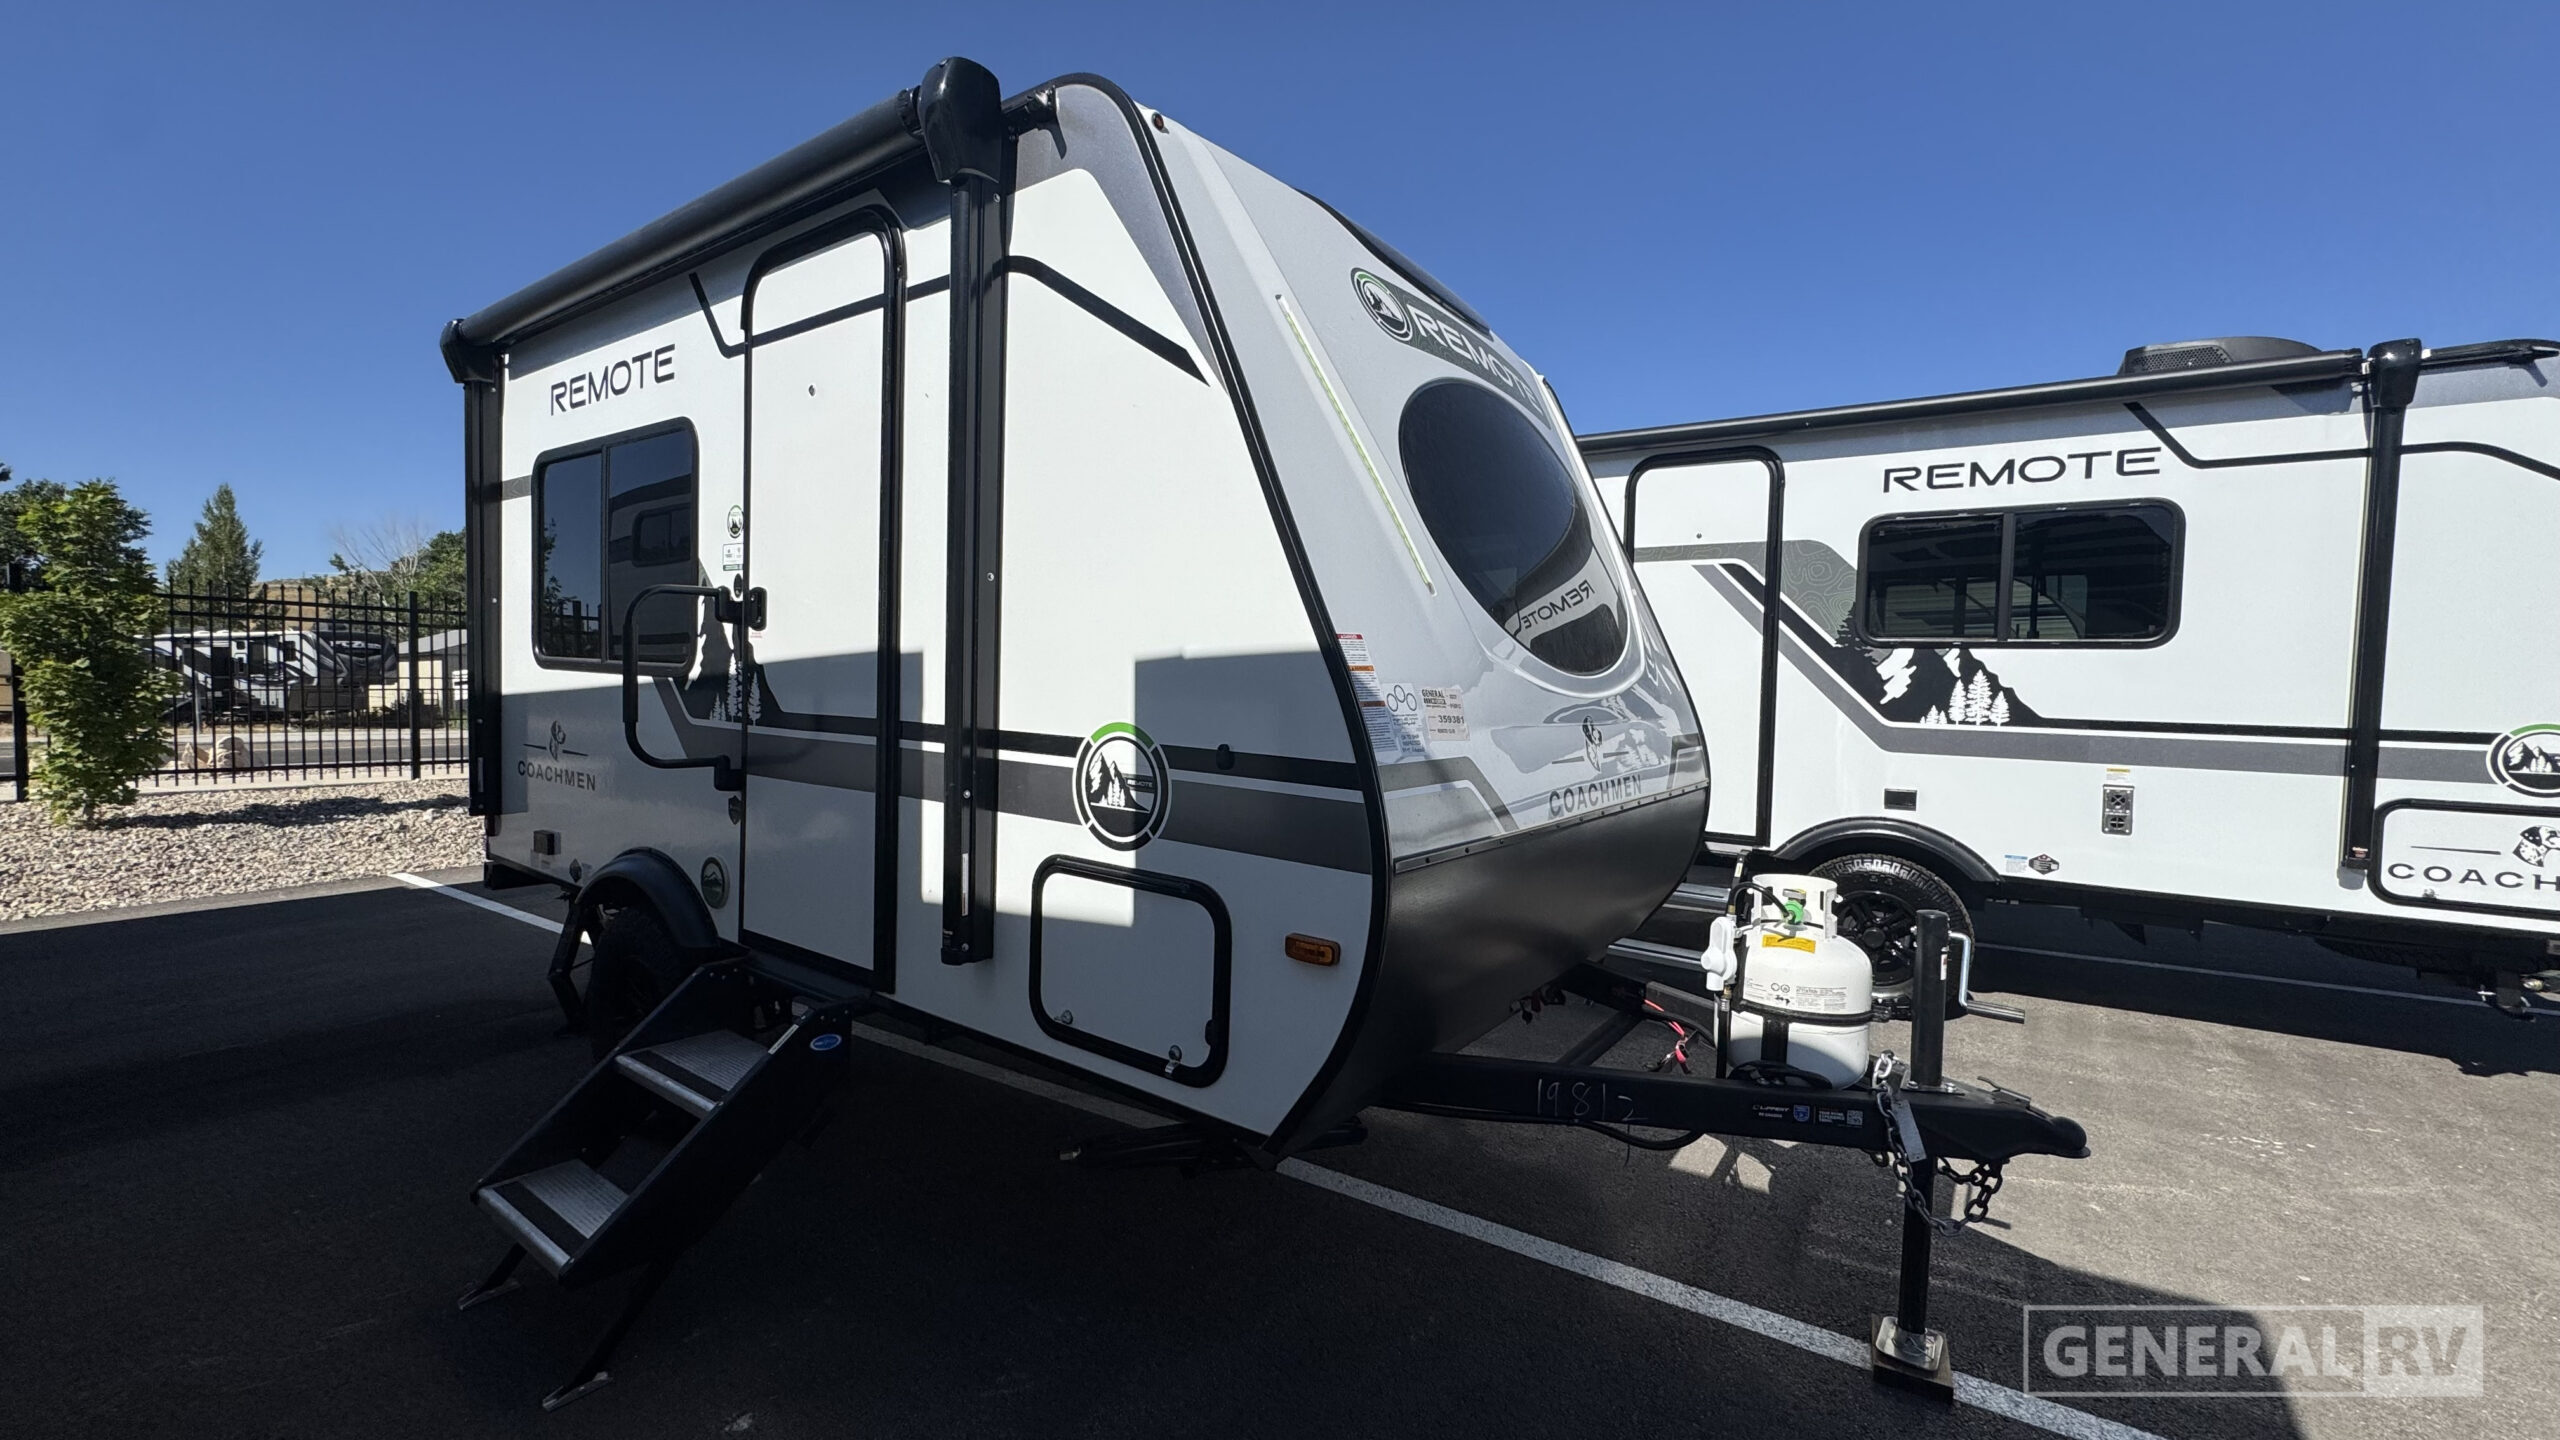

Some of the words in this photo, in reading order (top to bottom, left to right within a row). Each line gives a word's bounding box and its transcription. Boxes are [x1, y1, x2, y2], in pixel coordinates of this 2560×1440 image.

[551, 344, 675, 416] REMOTE
[1406, 303, 1544, 417] REMOTE
[1883, 447, 2161, 493] REMOTE
[1422, 689, 1445, 698] GENERAL
[1438, 715, 1465, 724] 359381
[518, 761, 596, 791] COACHMEN
[1549, 774, 1642, 816] COACHMEN
